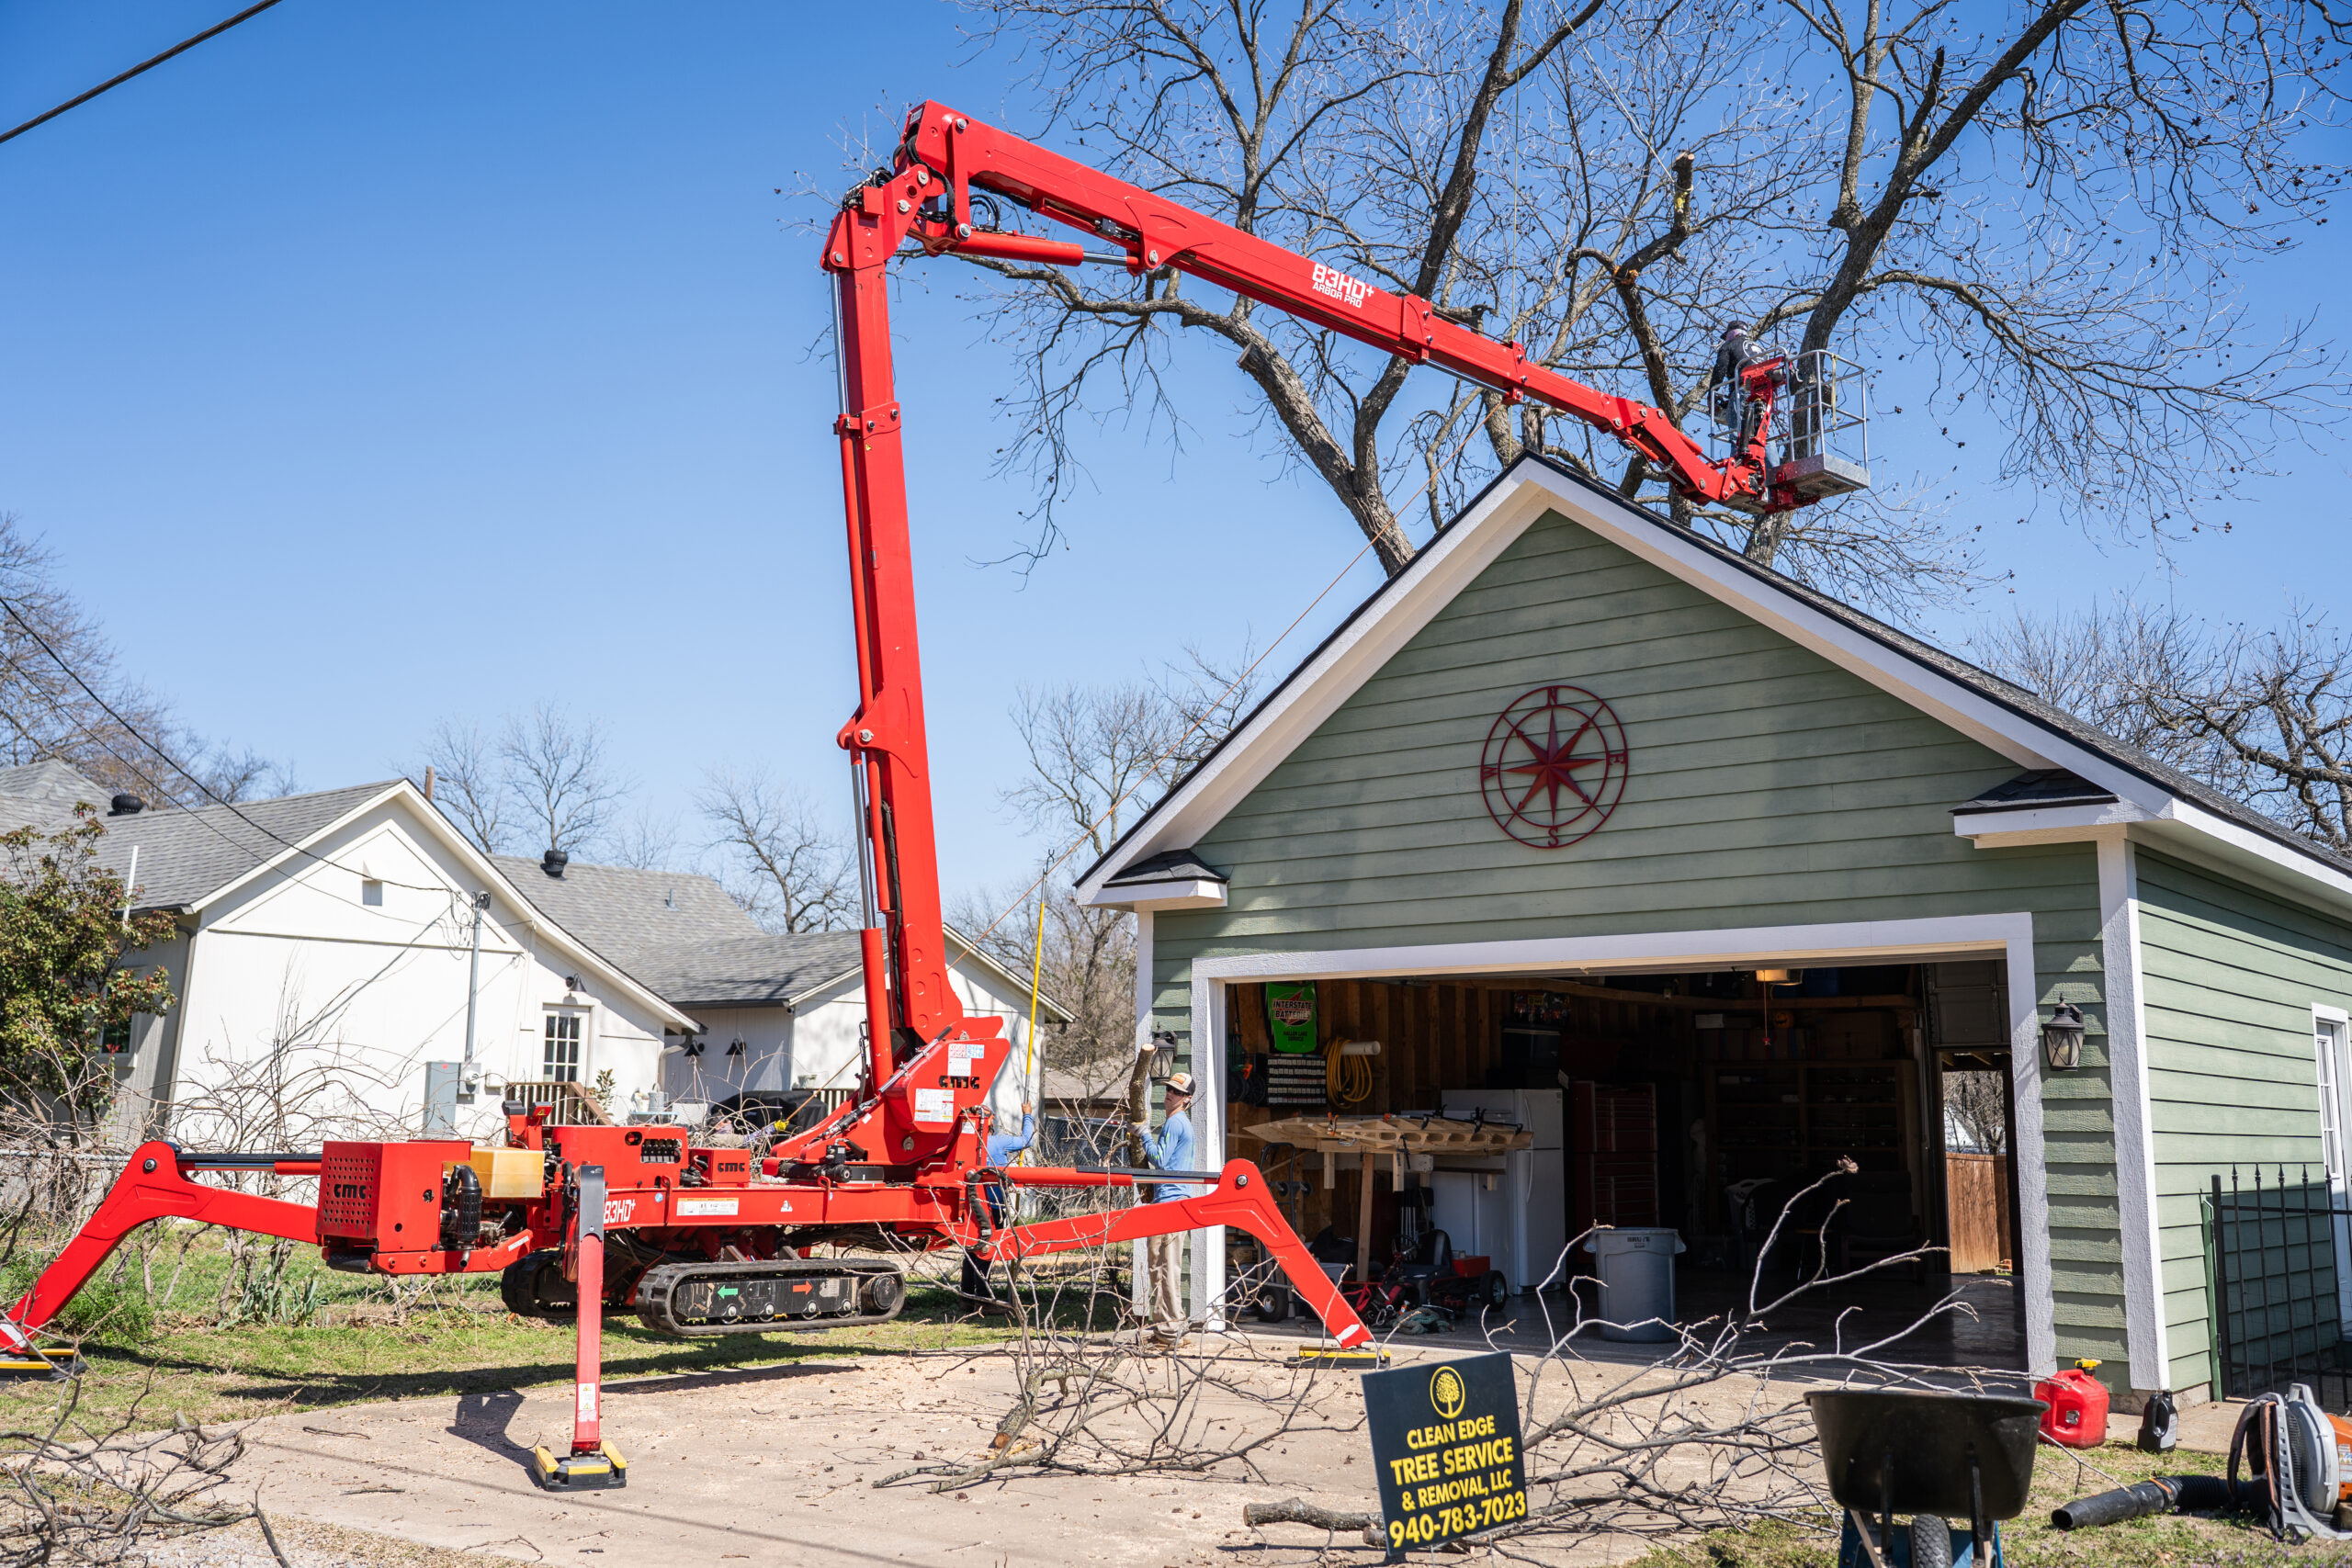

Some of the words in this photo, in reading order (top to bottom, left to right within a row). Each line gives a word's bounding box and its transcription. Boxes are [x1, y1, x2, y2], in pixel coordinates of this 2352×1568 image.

[1312, 263, 1374, 300] 83HD+
[1312, 282, 1342, 300] ARBOR
[1344, 294, 1363, 308] PRO
[1273, 1000, 1312, 1010] INTERSTATE
[1407, 1423, 1456, 1450] CLEAN
[1458, 1415, 1496, 1439] EDGE
[1390, 1452, 1440, 1485] TREE
[1442, 1437, 1514, 1475] SERVICE
[1401, 1491, 1416, 1512] &
[1418, 1475, 1489, 1508] REMOVAL,
[1490, 1468, 1512, 1490] LLC
[1389, 1491, 1526, 1548] 940-783-7023
